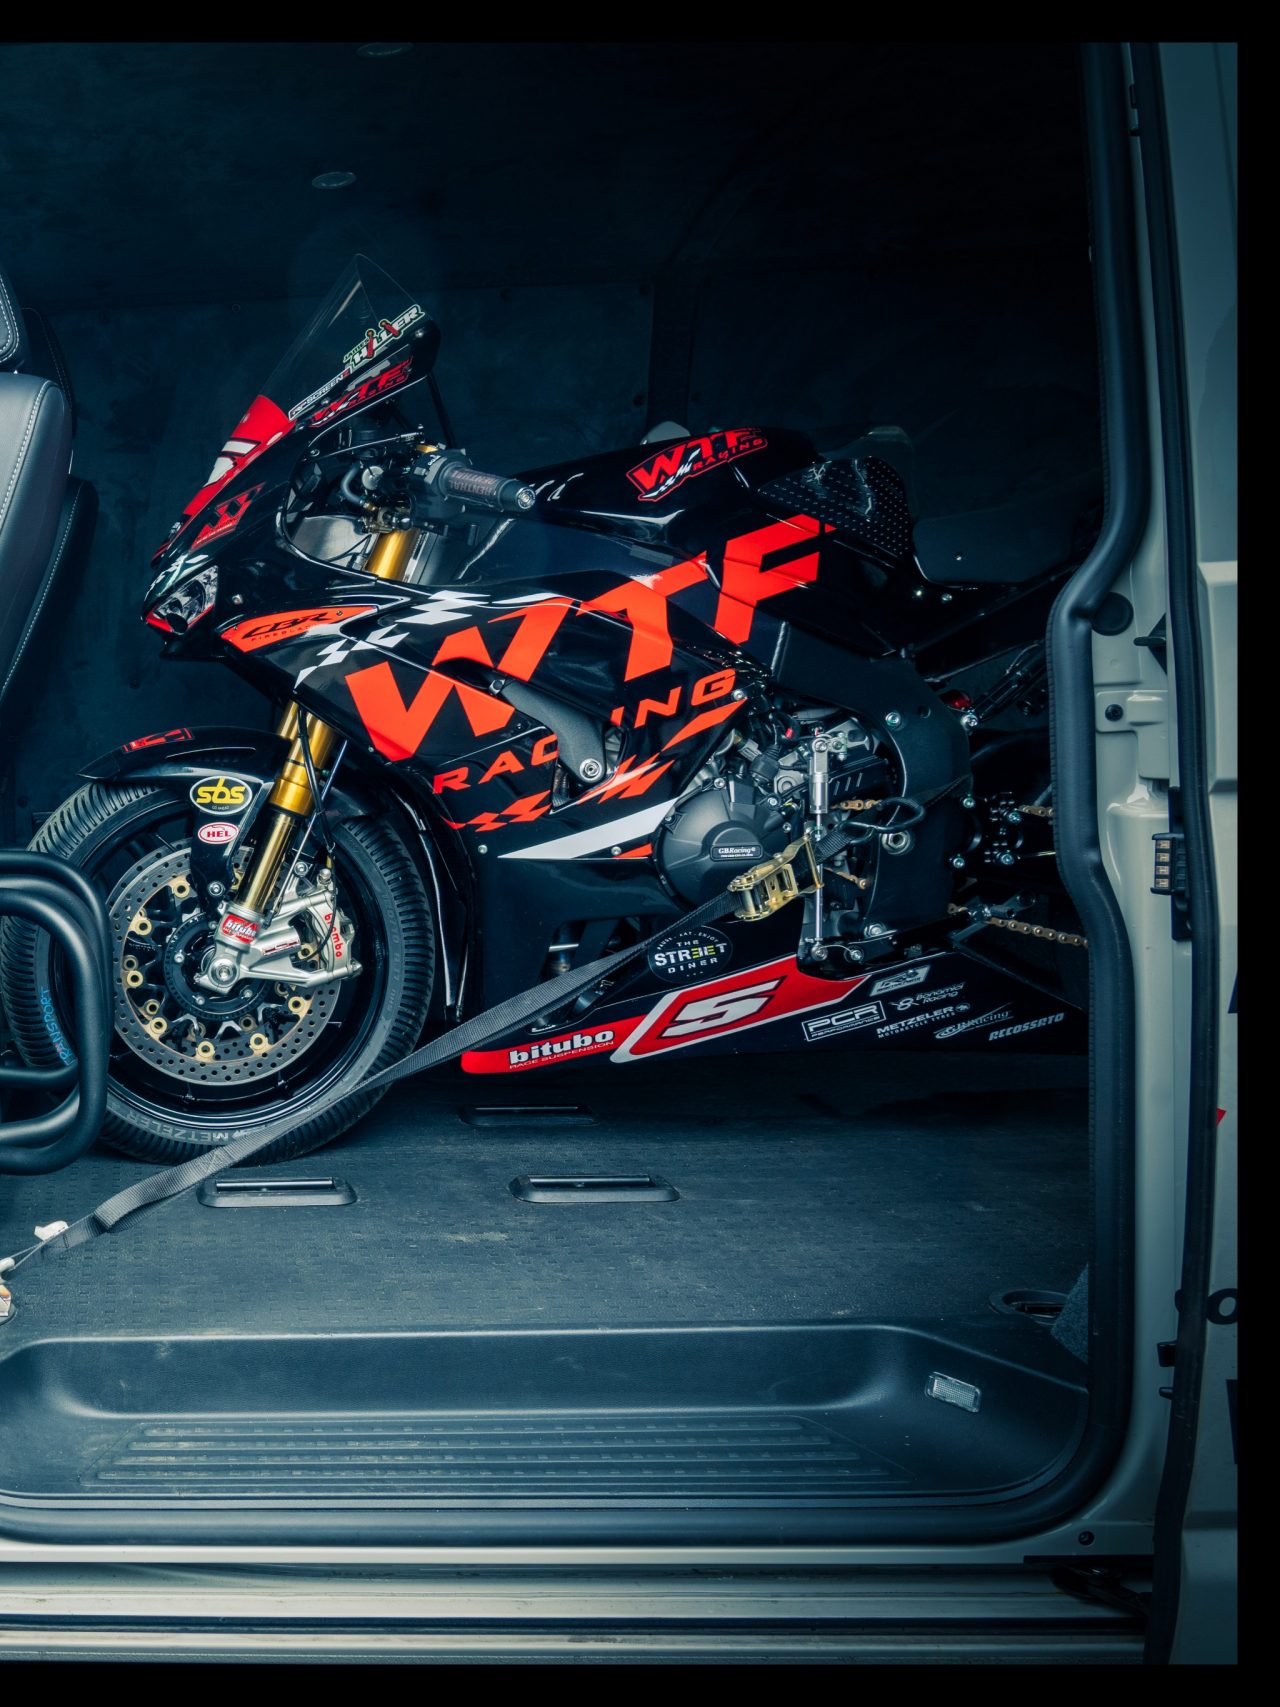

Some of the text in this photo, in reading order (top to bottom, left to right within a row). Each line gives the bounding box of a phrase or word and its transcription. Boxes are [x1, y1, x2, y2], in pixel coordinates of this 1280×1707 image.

[632, 430, 758, 491] WTF
[241, 611, 329, 640] CBR
[344, 513, 837, 762] WTF
[433, 668, 736, 794] RACING
[196, 777, 246, 804] sbs
[206, 830, 232, 838] HEL
[676, 939, 699, 947] THE
[667, 957, 718, 974] DINER
[659, 975, 787, 1039] 5
[807, 1005, 879, 1033] PCR
[876, 1006, 955, 1035] METZELER
[509, 1029, 615, 1065] bitubo
[509, 1040, 615, 1070] RACE SUSPENSION
[127, 1109, 229, 1142] METZELER
